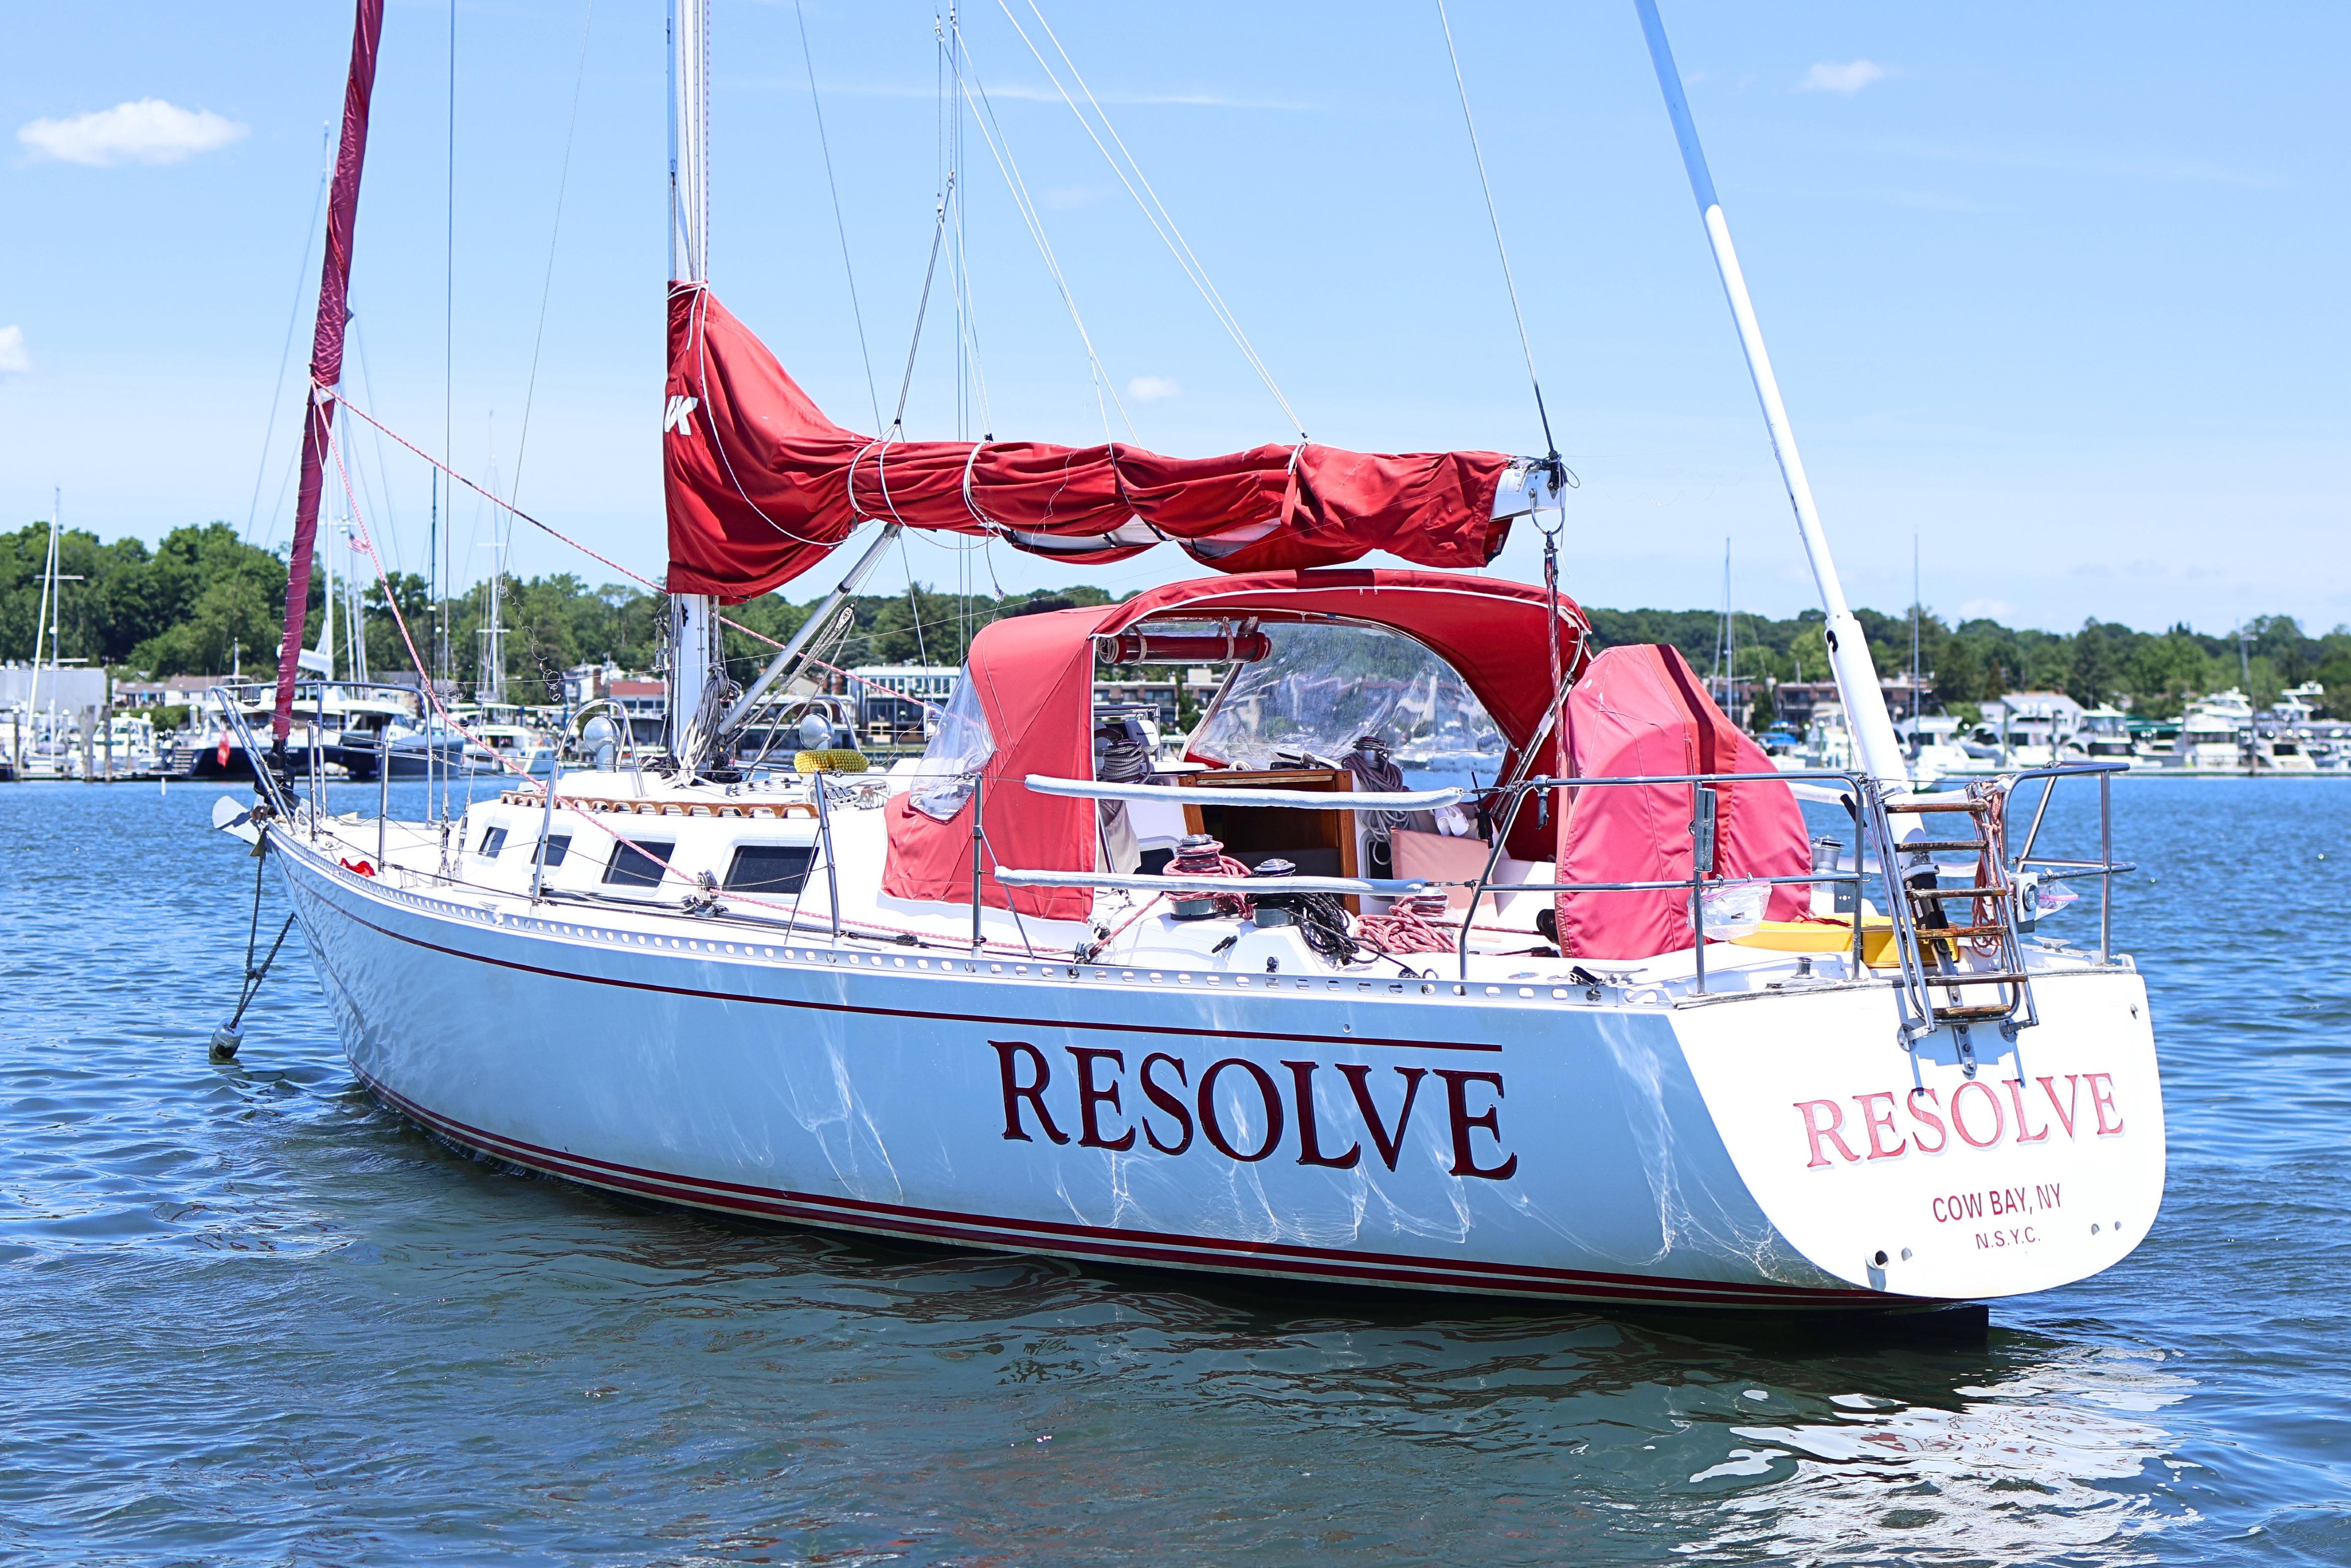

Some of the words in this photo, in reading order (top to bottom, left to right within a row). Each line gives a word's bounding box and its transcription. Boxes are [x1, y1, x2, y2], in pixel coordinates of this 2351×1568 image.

[987, 1040, 1517, 1181] RESOLVE
[1793, 1072, 2125, 1170] RESOLVE
[1933, 1192, 1982, 1223] COW
[1989, 1187, 2033, 1215] BAY,
[2036, 1183, 2061, 1210] NY
[1975, 1226, 2041, 1250] N.S.Y.C.
